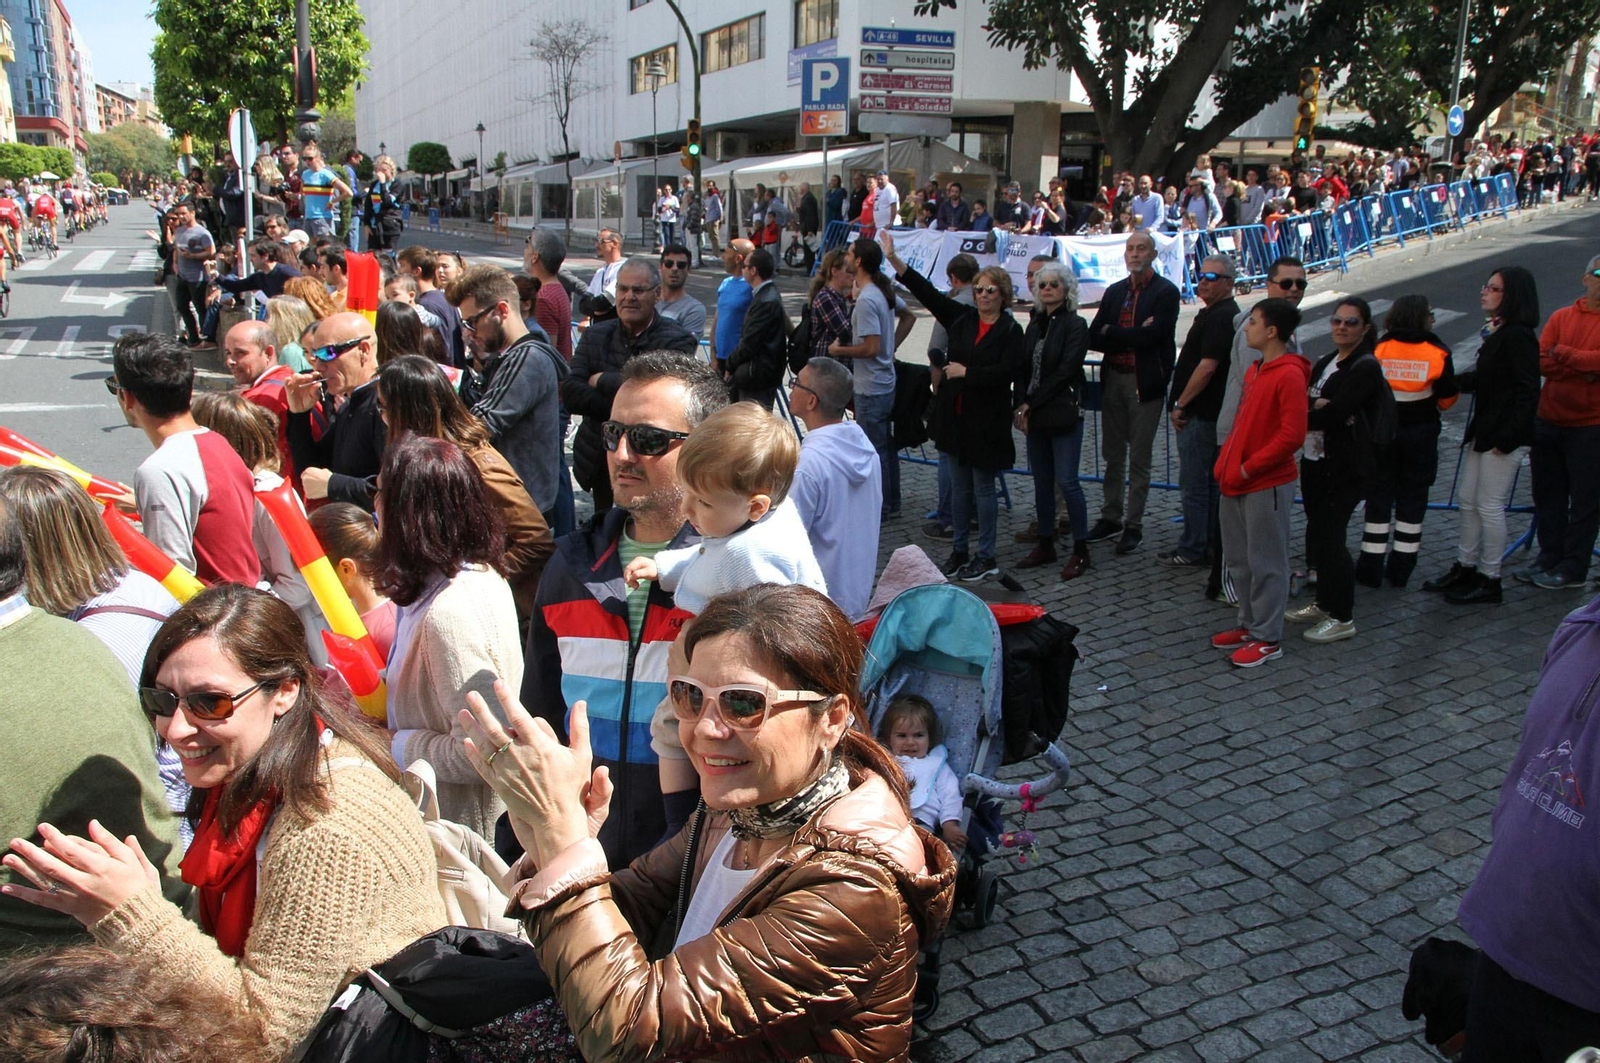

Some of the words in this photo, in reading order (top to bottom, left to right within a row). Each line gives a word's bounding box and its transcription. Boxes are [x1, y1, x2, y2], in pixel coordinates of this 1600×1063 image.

[879, 32, 898, 41] A-49
[915, 34, 952, 44] SEVILLA
[905, 55, 951, 65] hospitales
[812, 62, 840, 102] P
[904, 80, 913, 89] El
[917, 81, 950, 90] Carmen
[804, 103, 826, 111] PABLO
[899, 102, 909, 110] La
[914, 102, 949, 112] Soledad
